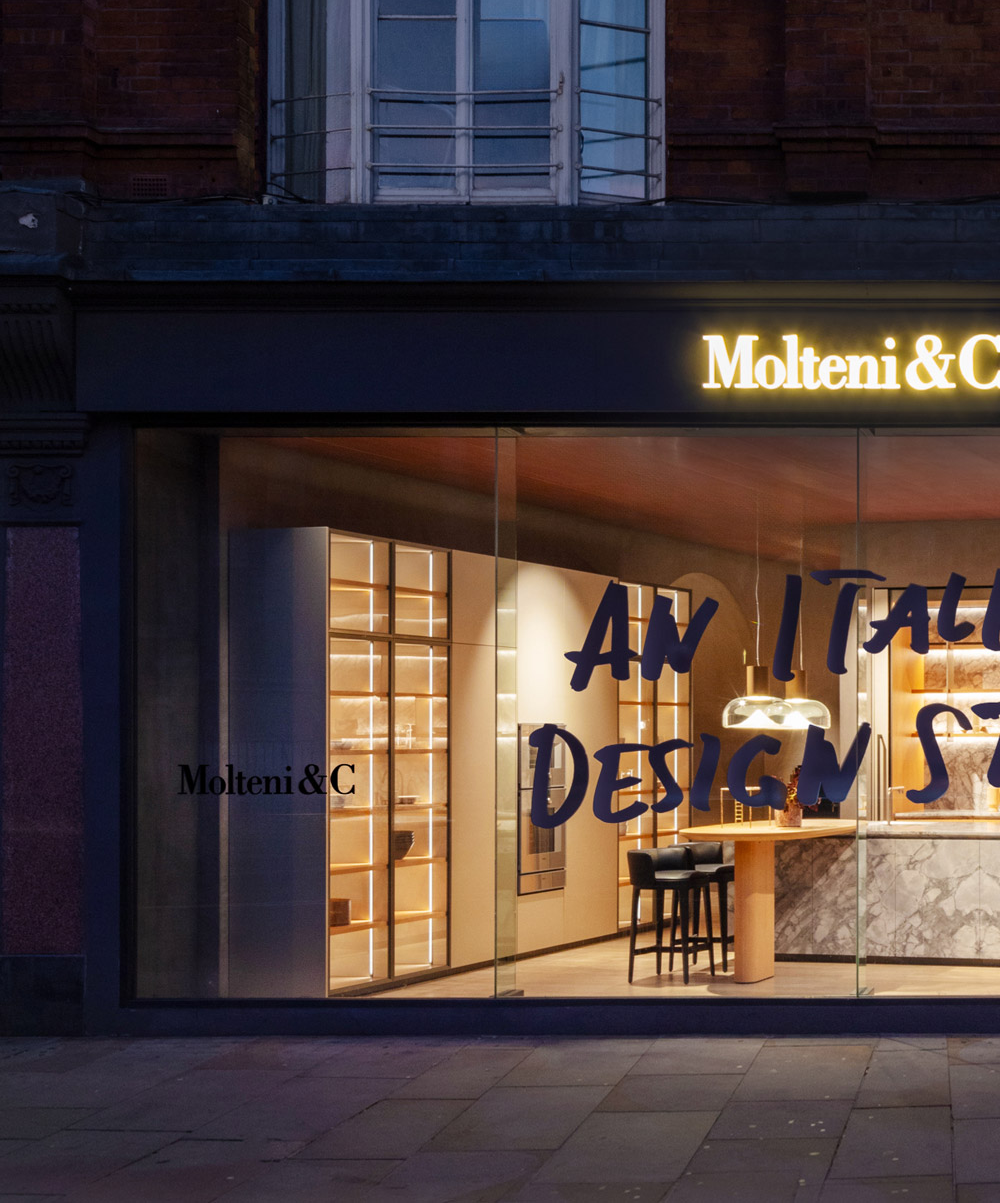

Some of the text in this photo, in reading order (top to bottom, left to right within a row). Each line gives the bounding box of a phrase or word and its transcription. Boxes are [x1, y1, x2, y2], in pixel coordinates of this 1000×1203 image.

[564, 581, 719, 692] AN
[177, 763, 356, 795] Molteni&C
[528, 722, 872, 830] DESIGN
